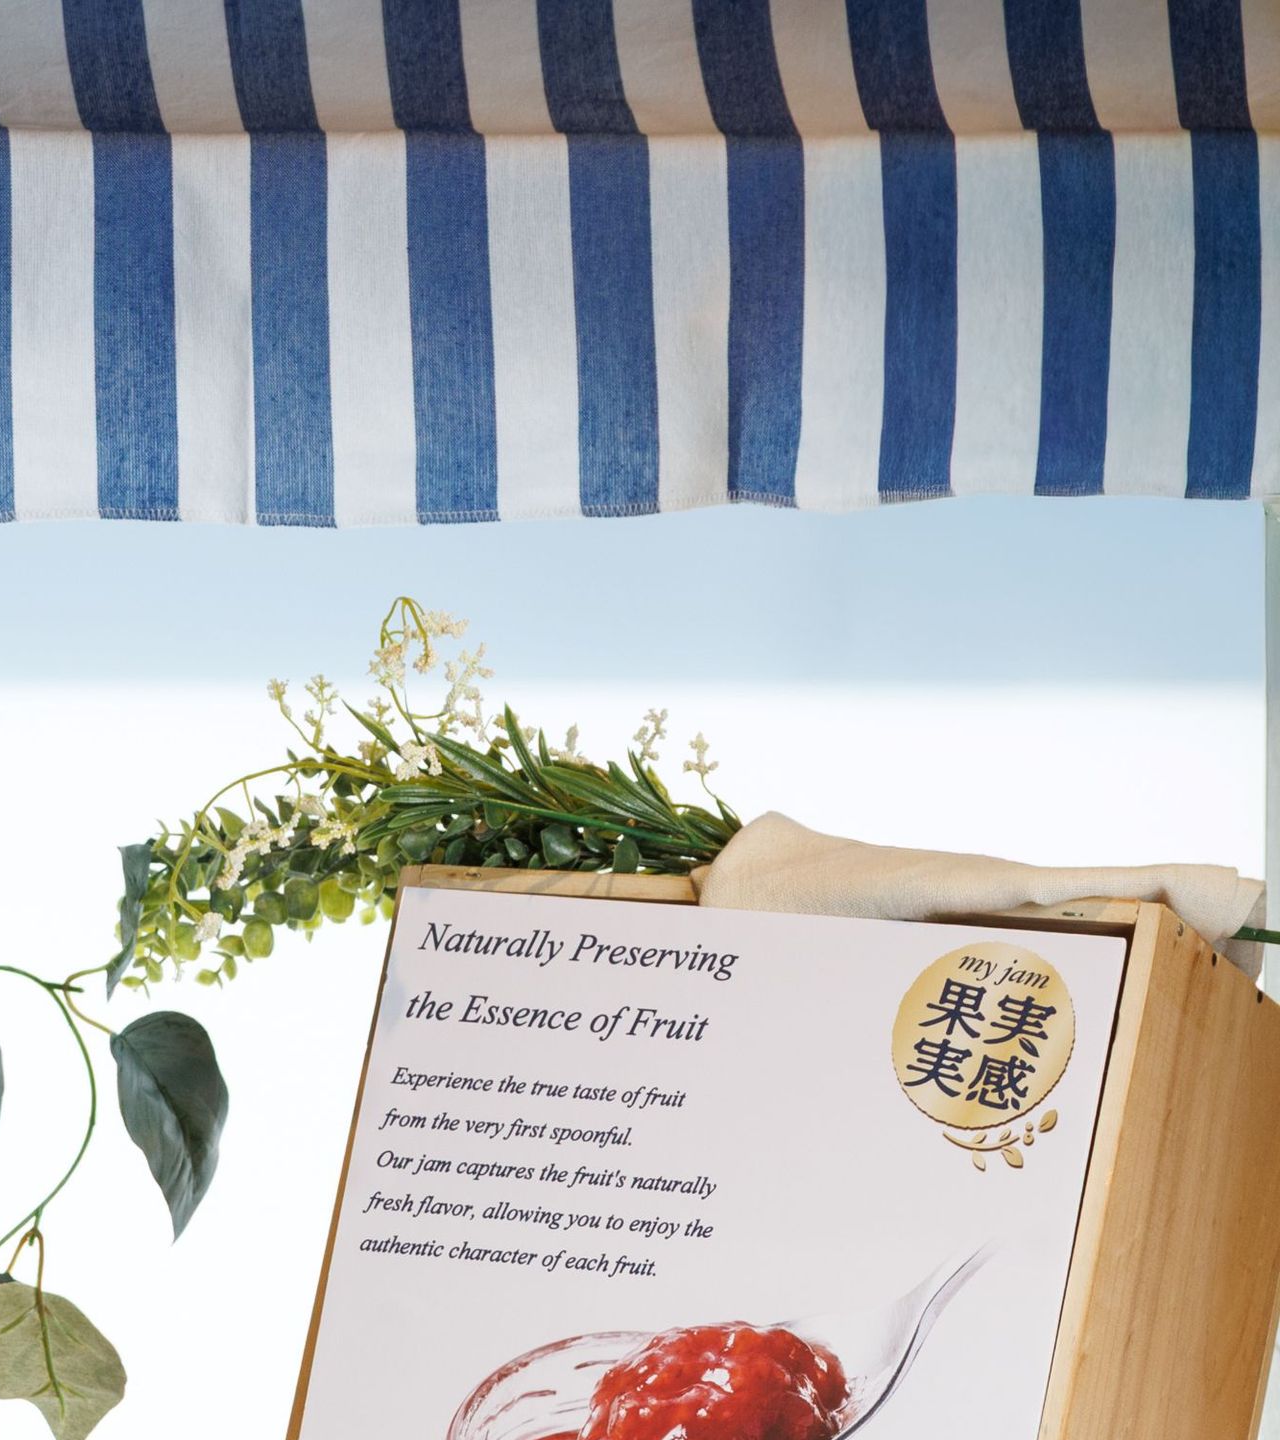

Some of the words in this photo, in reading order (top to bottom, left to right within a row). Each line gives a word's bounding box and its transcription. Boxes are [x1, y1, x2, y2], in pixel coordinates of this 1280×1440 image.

[416, 921, 565, 968] Naturally
[568, 933, 740, 982] Preserving
[957, 955, 998, 982] my
[993, 959, 1051, 990] jam
[405, 990, 454, 1022] the
[457, 994, 583, 1032] Essence
[589, 1006, 627, 1042] of
[627, 1008, 711, 1042] Fruit
[390, 1067, 495, 1092] Experience
[497, 1074, 528, 1095] the
[530, 1079, 570, 1098] true
[572, 1083, 618, 1103] taste
[621, 1086, 645, 1109] of
[638, 1087, 687, 1110] fruit
[377, 1107, 428, 1131] from
[430, 1111, 461, 1132] the
[465, 1118, 504, 1142] very
[503, 1119, 549, 1141] first
[549, 1127, 633, 1149] spoonful.
[376, 1150, 414, 1170] Our
[412, 1154, 453, 1176] jam
[455, 1161, 536, 1181] captures
[539, 1163, 569, 1184] the
[567, 1166, 628, 1189] fruit's
[630, 1175, 718, 1201] naturally
[361, 1190, 414, 1214] fresh
[412, 1195, 475, 1221] flavor,
[481, 1201, 565, 1230] allowing
[562, 1213, 603, 1231] you
[605, 1214, 625, 1231] to
[628, 1216, 681, 1240] enjoy
[683, 1218, 715, 1239] the
[359, 1234, 445, 1258] authentic
[448, 1240, 539, 1266] character
[541, 1249, 567, 1273] of
[564, 1252, 610, 1273] each
[607, 1254, 657, 1279] fruit.
